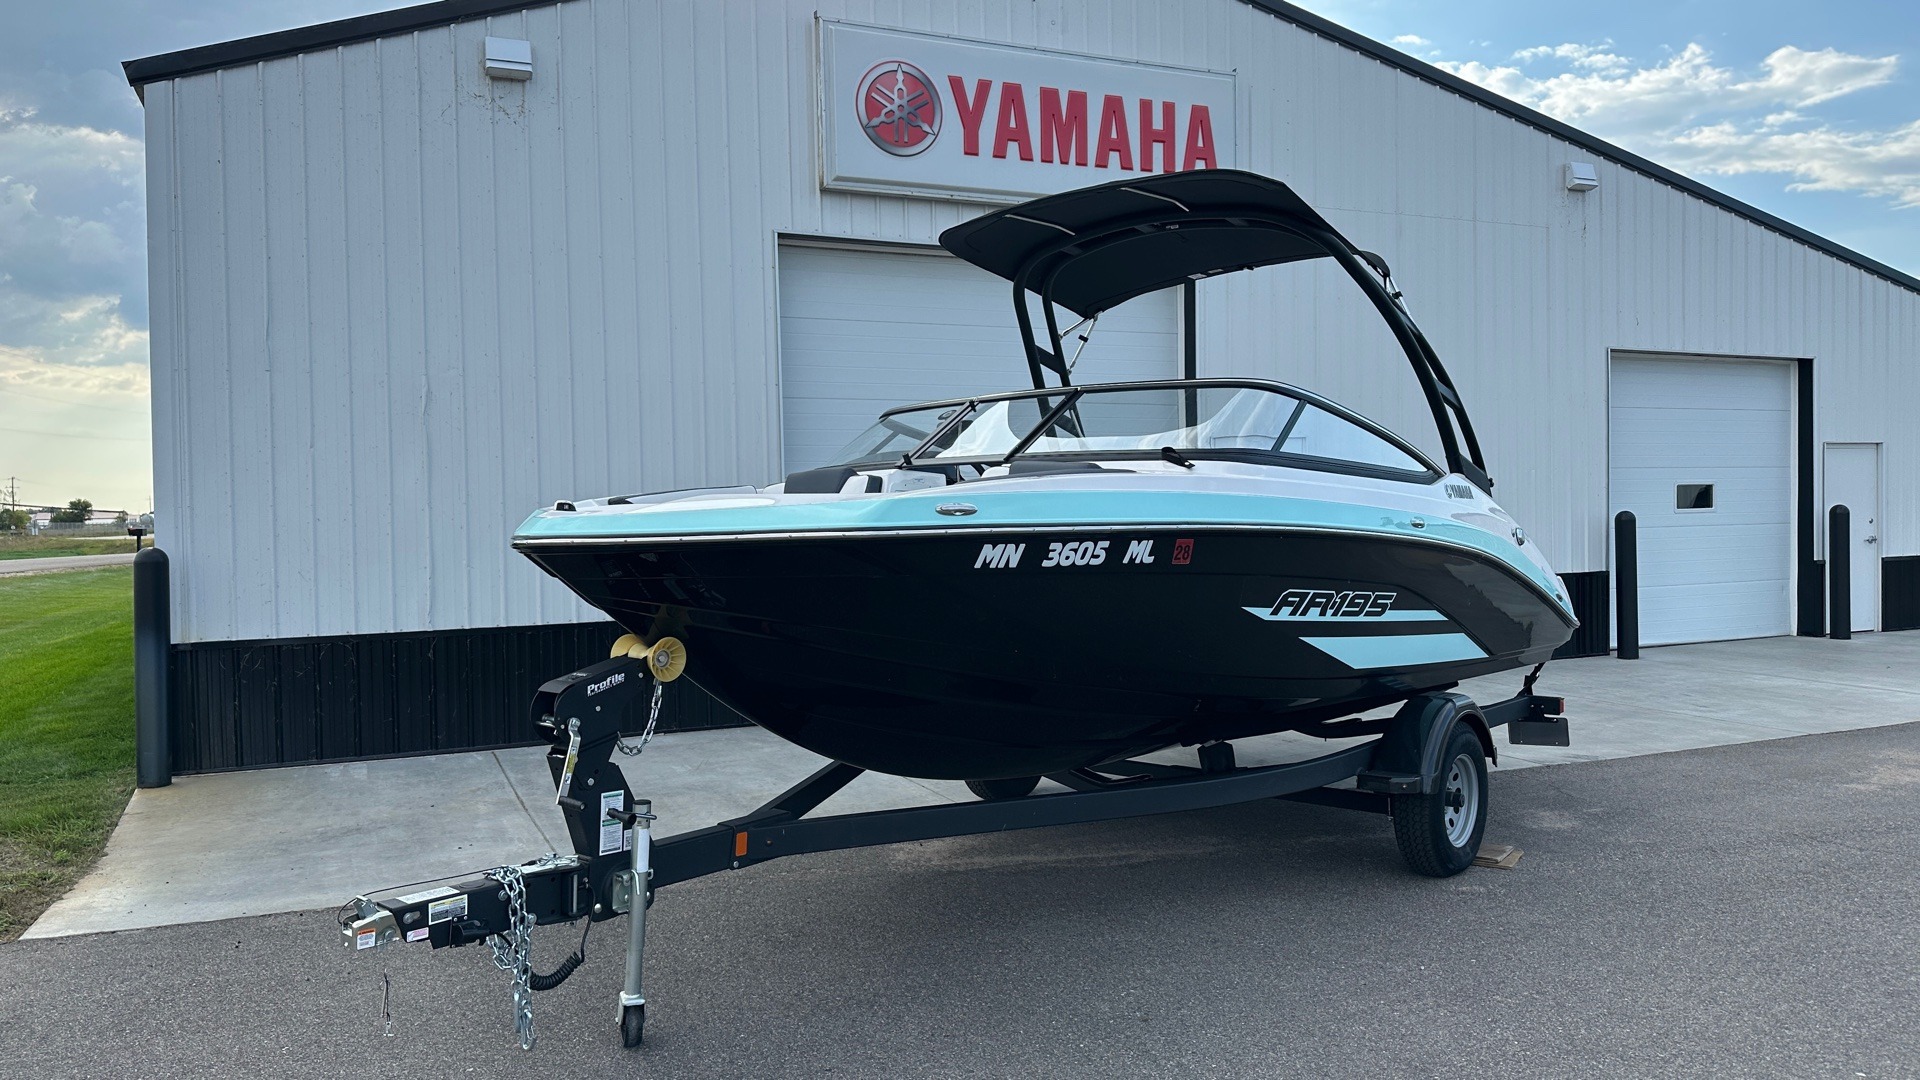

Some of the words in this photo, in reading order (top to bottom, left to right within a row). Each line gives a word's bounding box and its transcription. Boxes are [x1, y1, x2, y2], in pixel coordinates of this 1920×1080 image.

[947, 75, 1218, 173] YAMAHA
[974, 543, 1026, 569] MN
[1041, 540, 1110, 568] 3605
[1122, 539, 1155, 564] ML
[1174, 544, 1191, 561] 28
[1269, 589, 1397, 617] AR195
[587, 673, 625, 694] Profile
